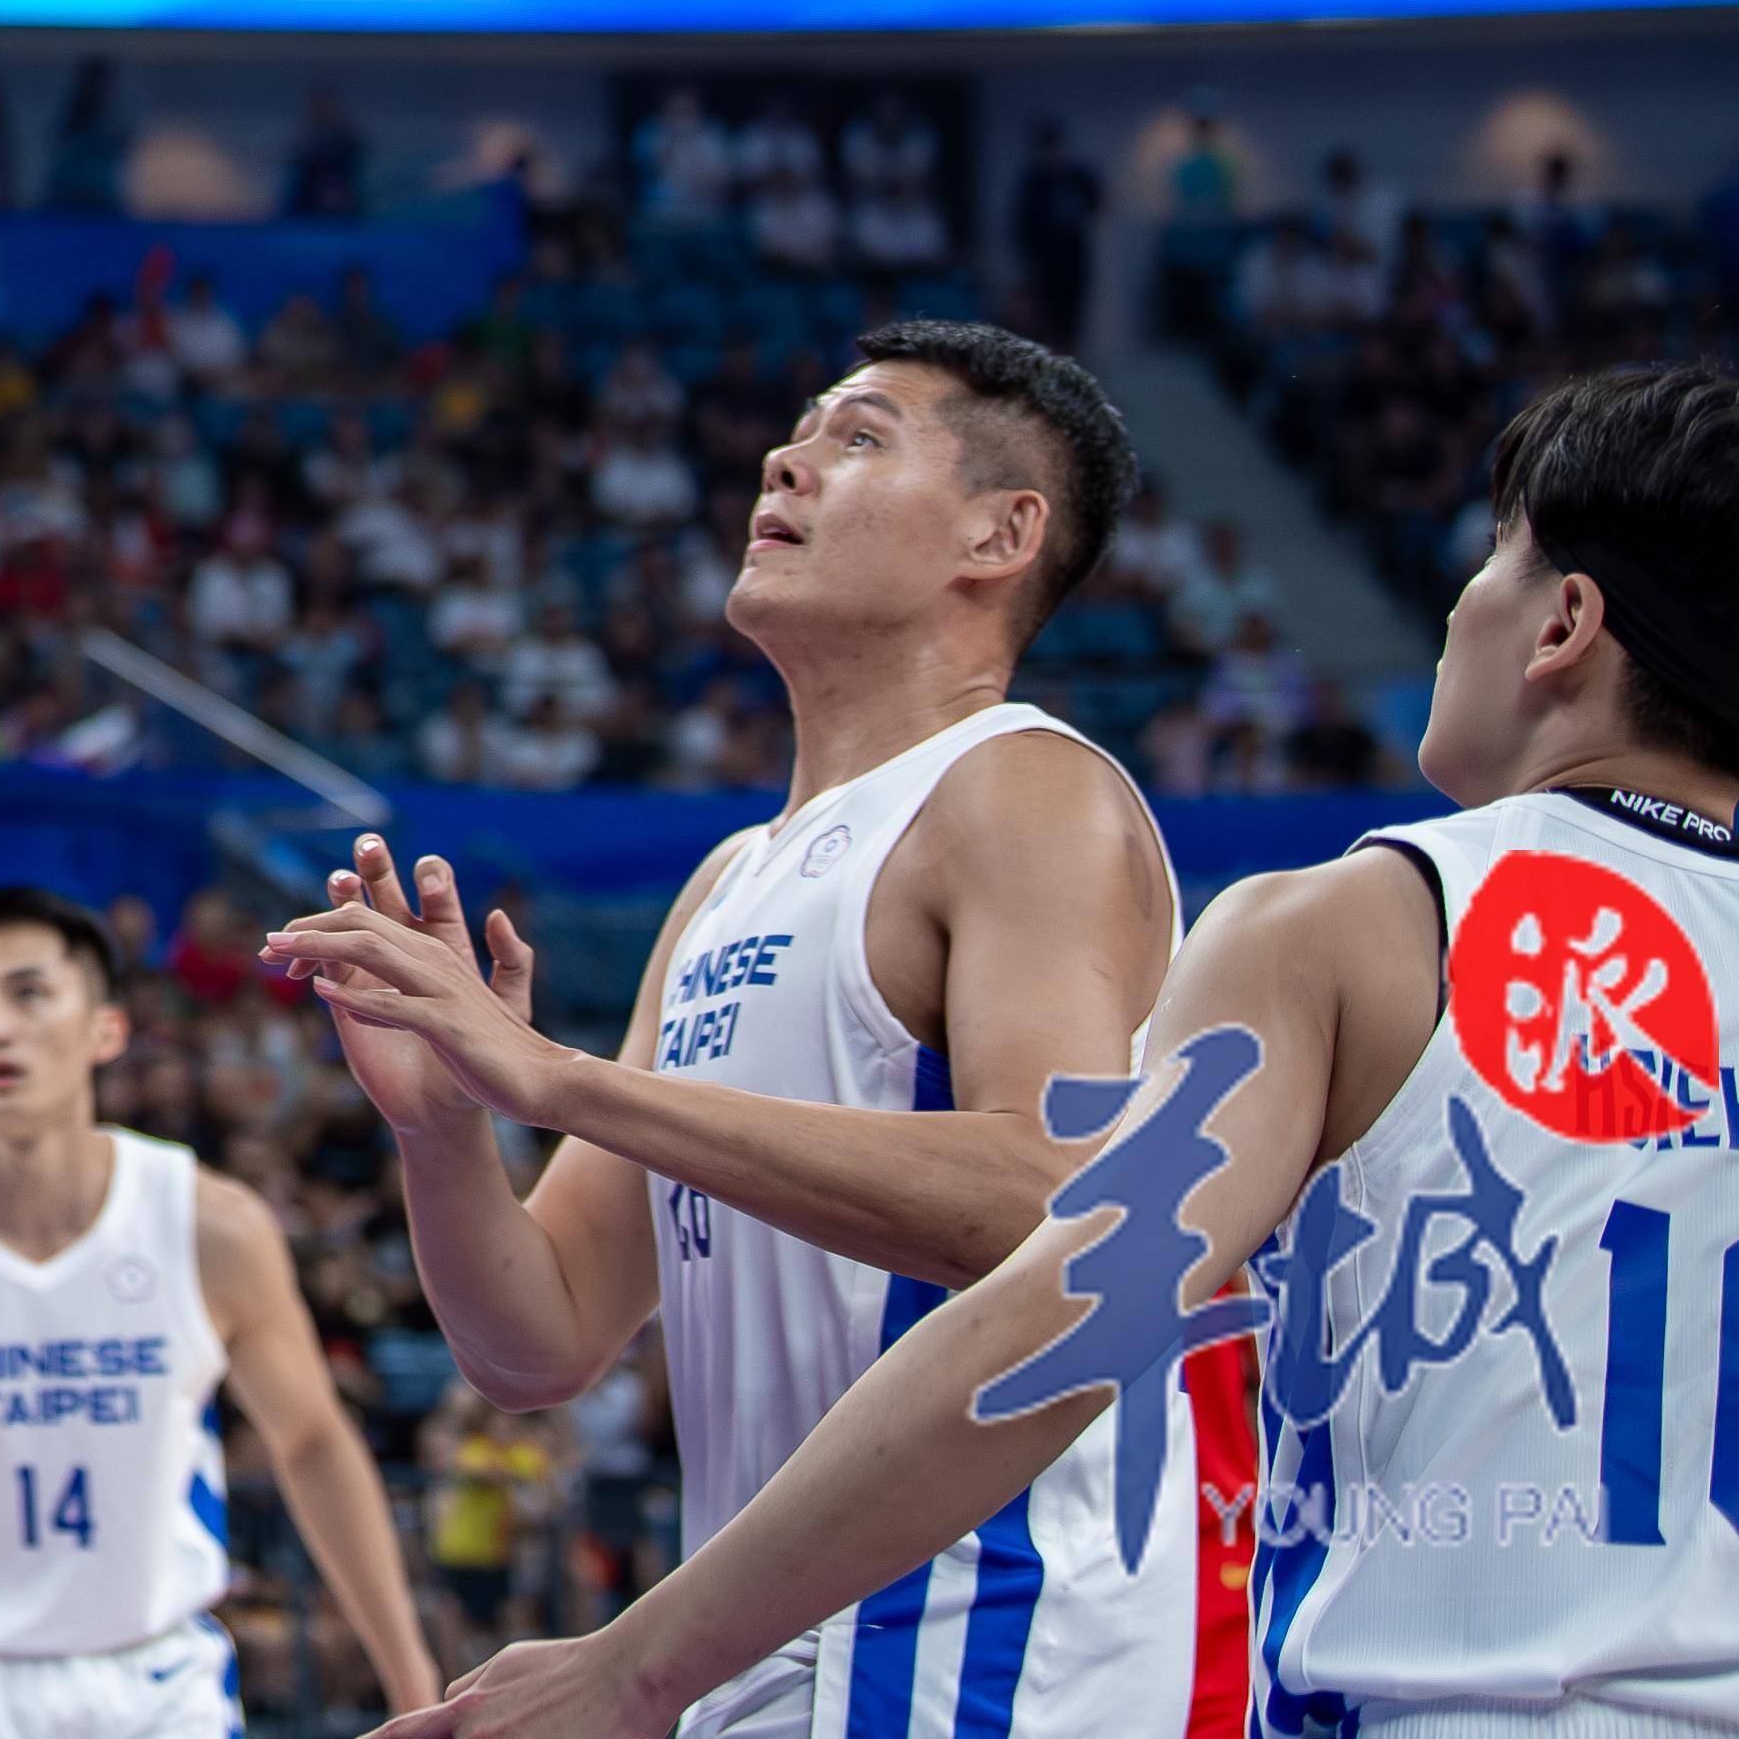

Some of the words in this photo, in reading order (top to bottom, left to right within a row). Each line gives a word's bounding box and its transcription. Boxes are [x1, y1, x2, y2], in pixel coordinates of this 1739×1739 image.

[1610, 788, 1684, 826] NIKE
[1684, 811, 1732, 844] PRO
[669, 934, 795, 1007] HINESE
[657, 1001, 741, 1072] TAIPEI
[1574, 1033, 1739, 1151] HSIE
[1591, 1198, 1739, 1546] 1
[15, 1465, 94, 1549] 14
